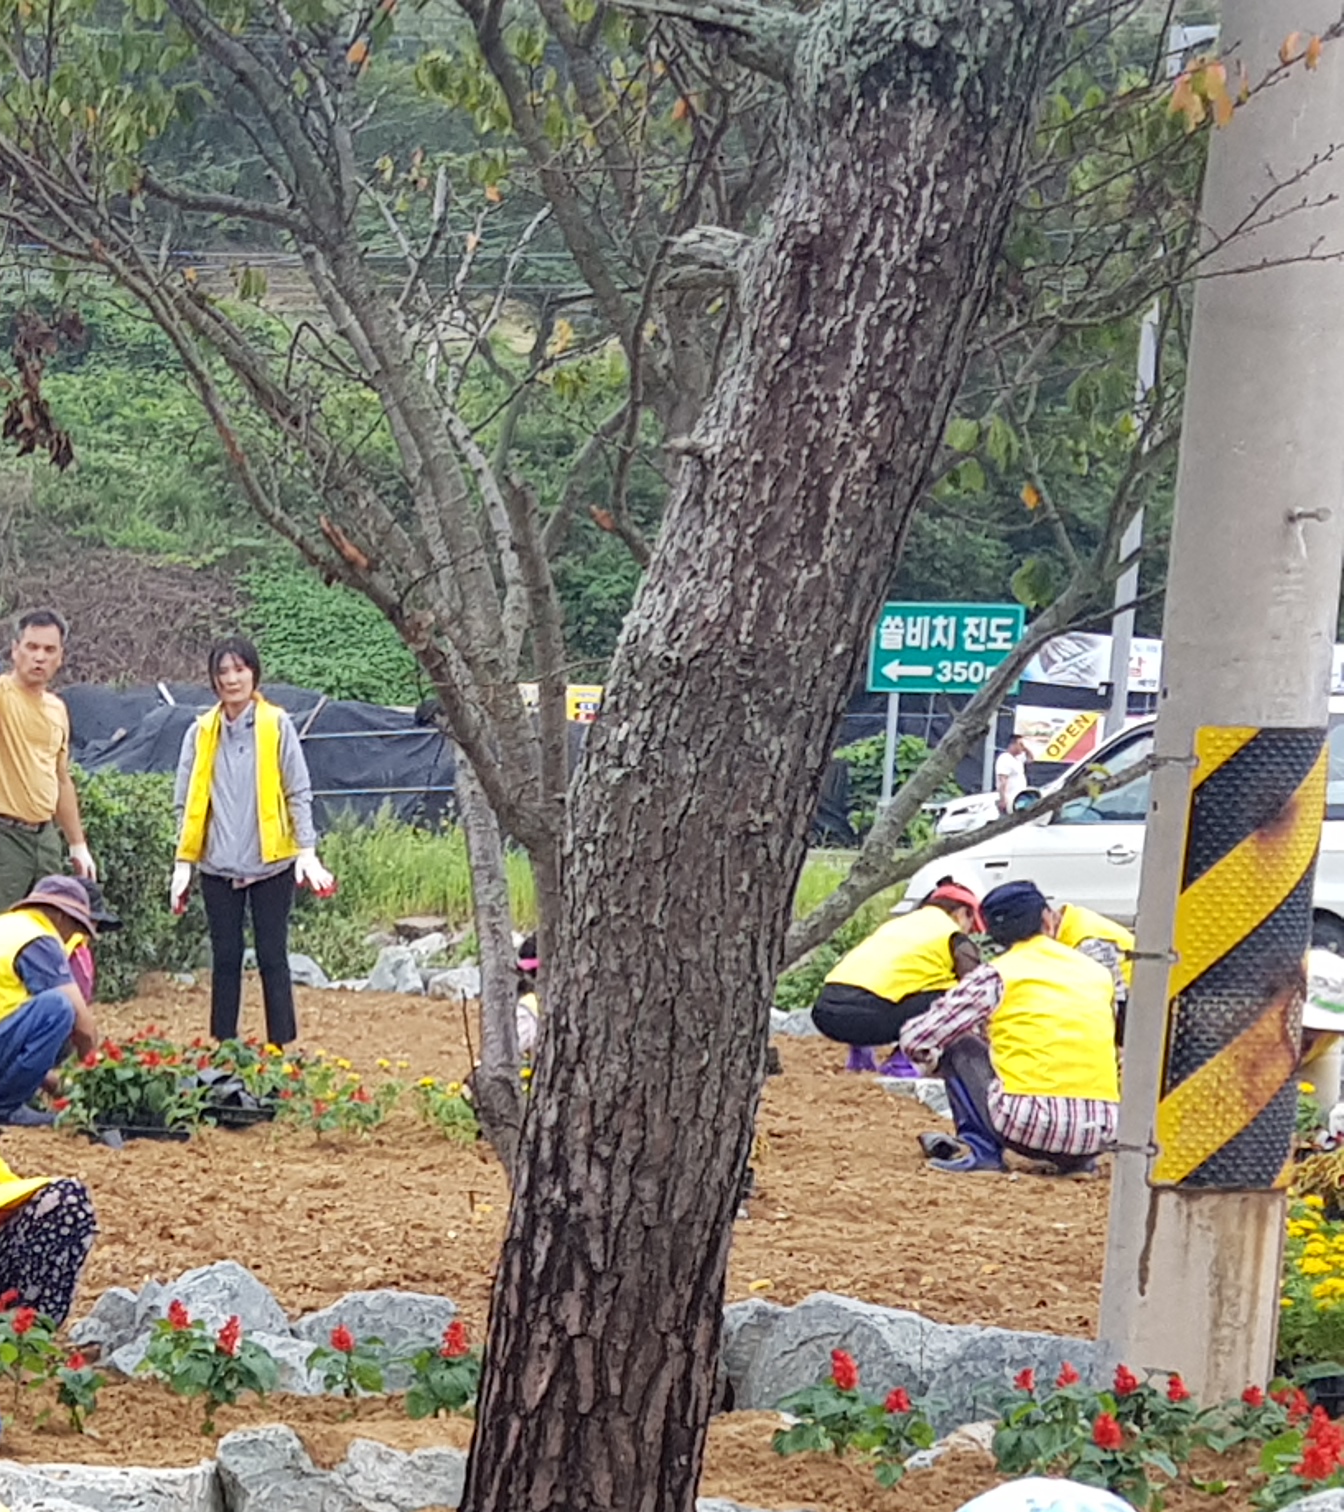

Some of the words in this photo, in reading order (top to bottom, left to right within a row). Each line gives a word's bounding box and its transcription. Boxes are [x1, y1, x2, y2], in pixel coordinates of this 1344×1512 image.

[879, 615, 957, 651] 쏠비치
[963, 616, 1014, 652] 진도
[1046, 714, 1090, 757] OPEN
